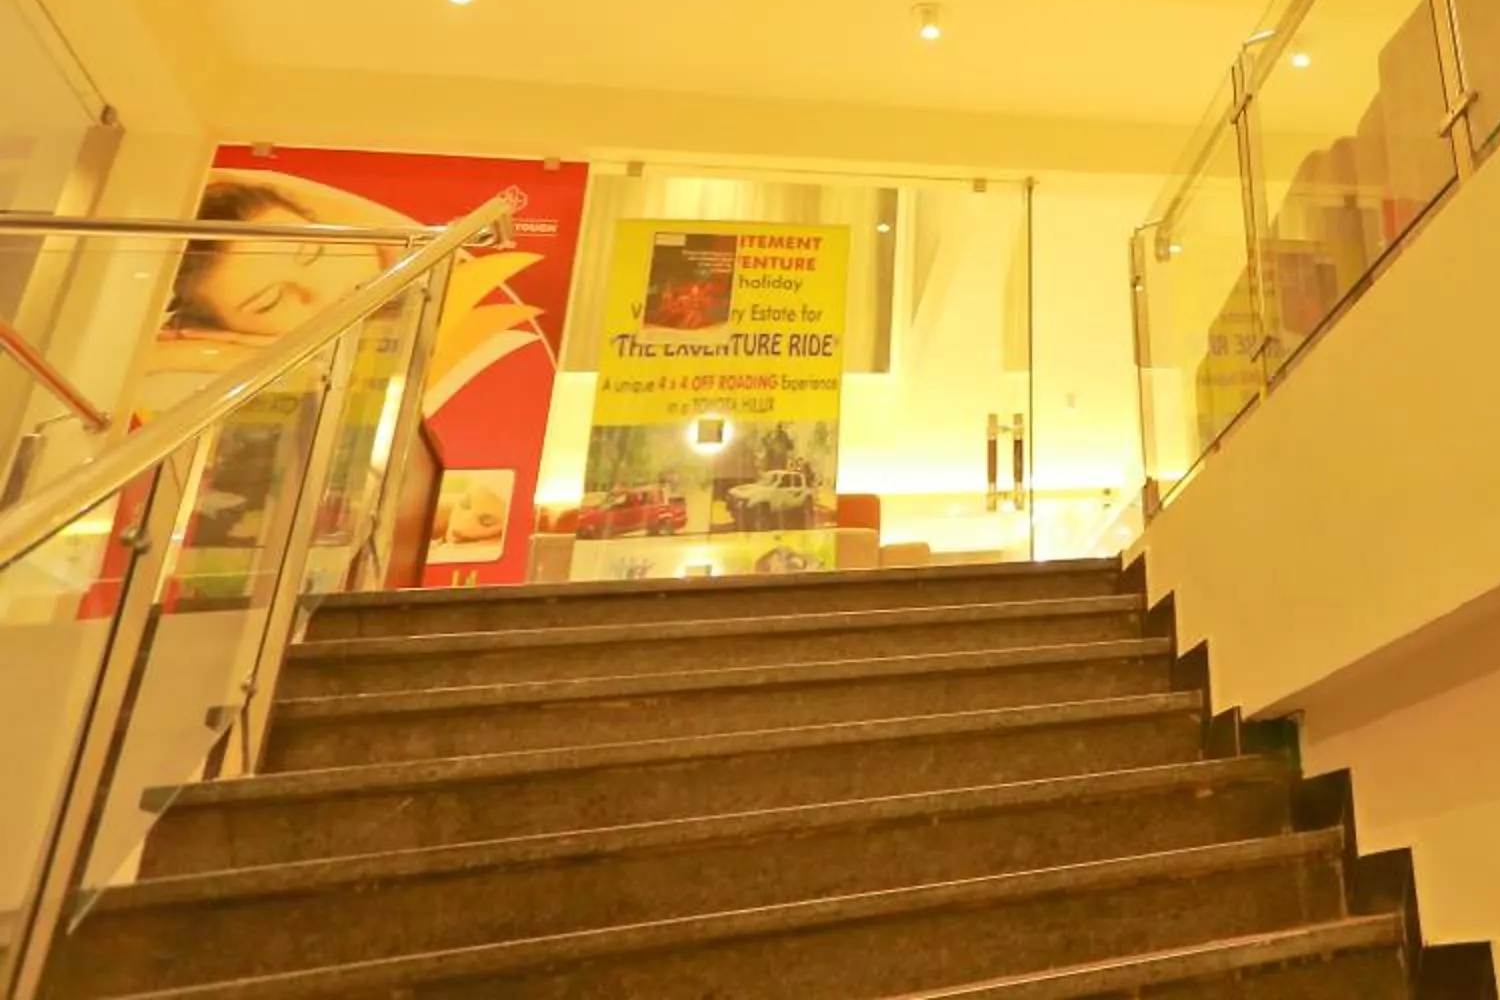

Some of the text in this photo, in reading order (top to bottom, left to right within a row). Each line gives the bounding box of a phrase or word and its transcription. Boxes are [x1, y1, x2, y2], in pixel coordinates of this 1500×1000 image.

[740, 235, 823, 250] ITEMENT
[740, 255, 816, 271] ENTURE
[739, 274, 804, 293] holiday
[752, 304, 797, 322] Estate
[801, 304, 823, 322] for
[692, 375, 714, 391] OFF
[718, 375, 779, 391] ROADING
